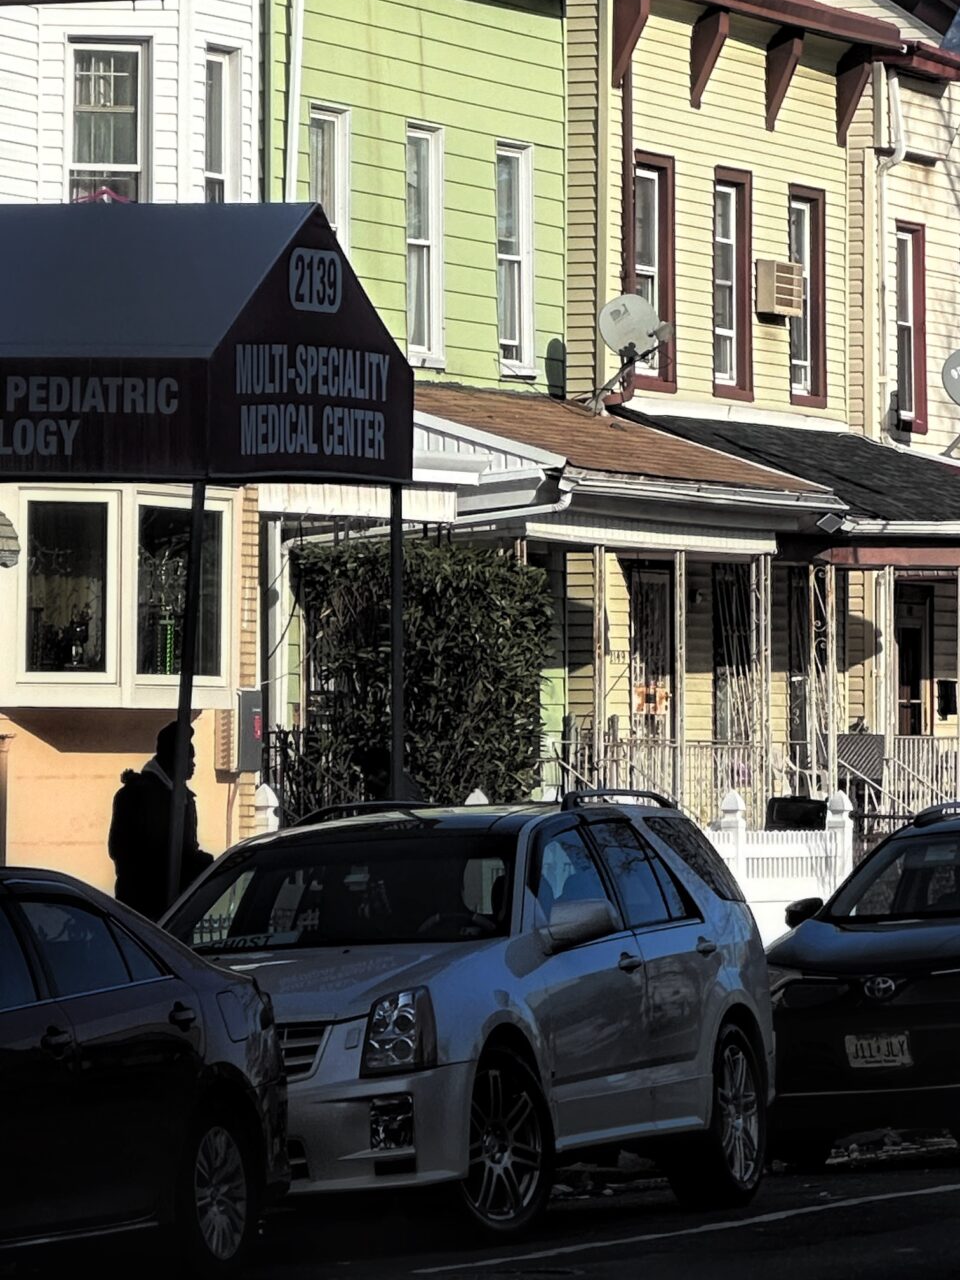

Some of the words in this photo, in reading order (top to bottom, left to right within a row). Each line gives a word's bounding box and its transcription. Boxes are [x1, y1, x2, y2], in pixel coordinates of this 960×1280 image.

[294, 256, 337, 307] 2139
[6, 375, 179, 415] PEDIATRIC
[235, 344, 390, 402] MULTI-SPECIALITY
[240, 403, 318, 456] MEDICAL
[322, 407, 385, 460] CENTER
